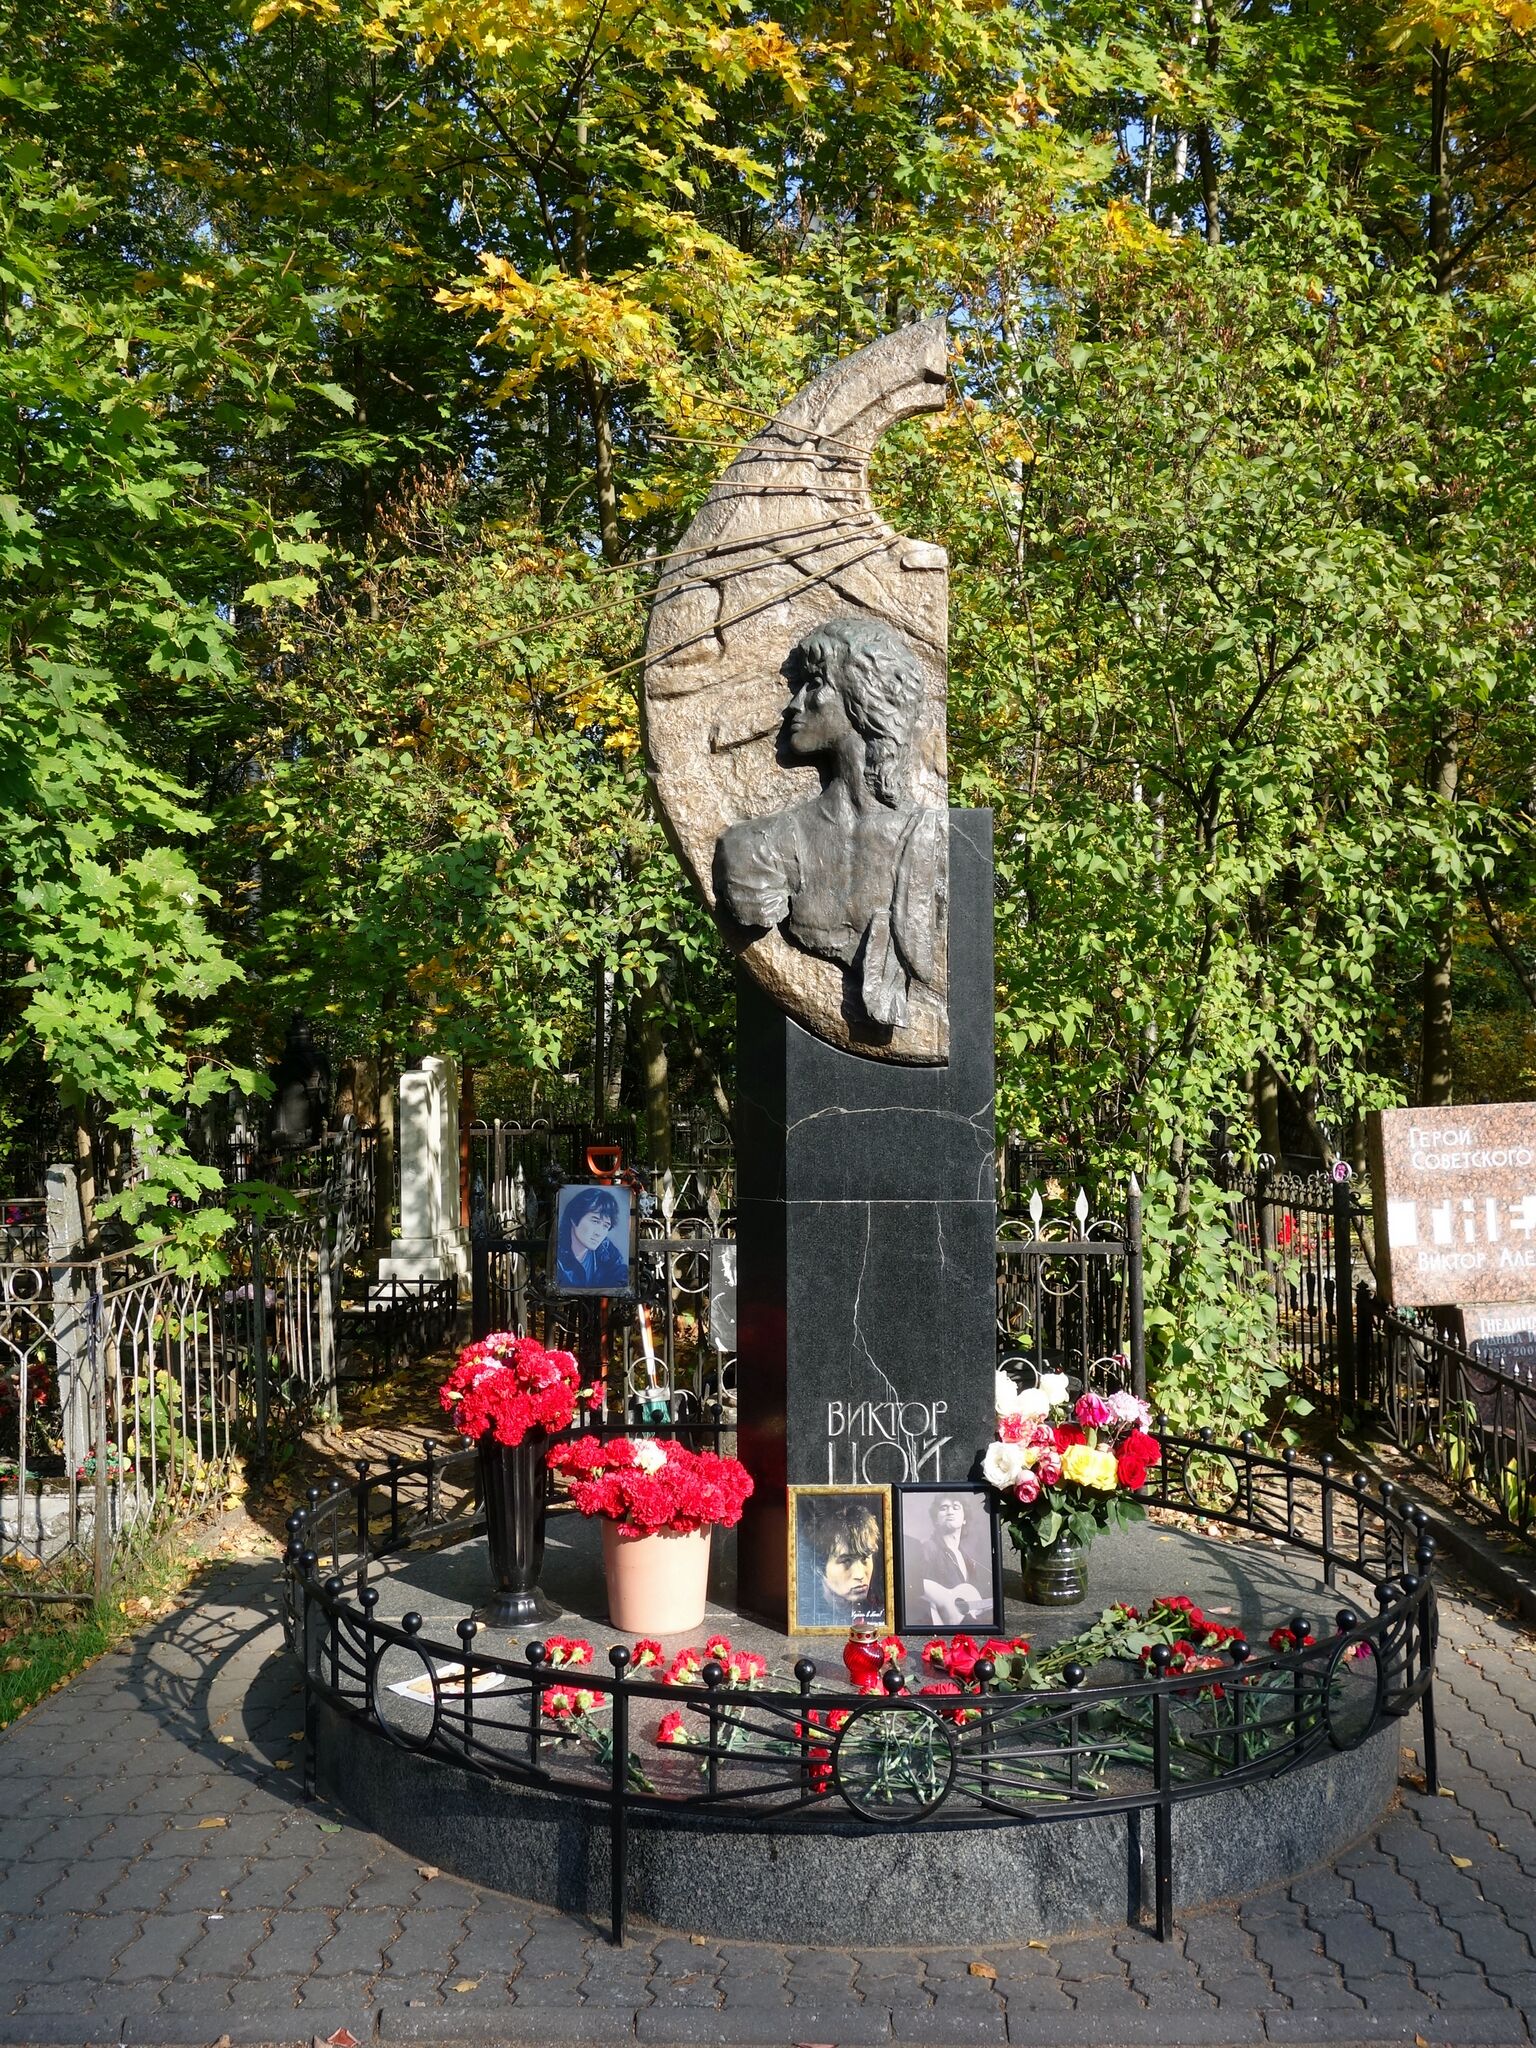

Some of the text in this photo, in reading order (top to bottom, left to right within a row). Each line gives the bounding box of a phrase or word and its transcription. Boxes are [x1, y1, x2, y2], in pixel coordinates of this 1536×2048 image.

[1408, 1126, 1472, 1149] ГЕРОЙ
[1412, 1148, 1533, 1171] СОВЕТСКОГО
[1418, 1251, 1486, 1272] ВИКТОР
[827, 1400, 948, 1440] ВИКТОР
[827, 1436, 953, 1485] ЦОЙ
